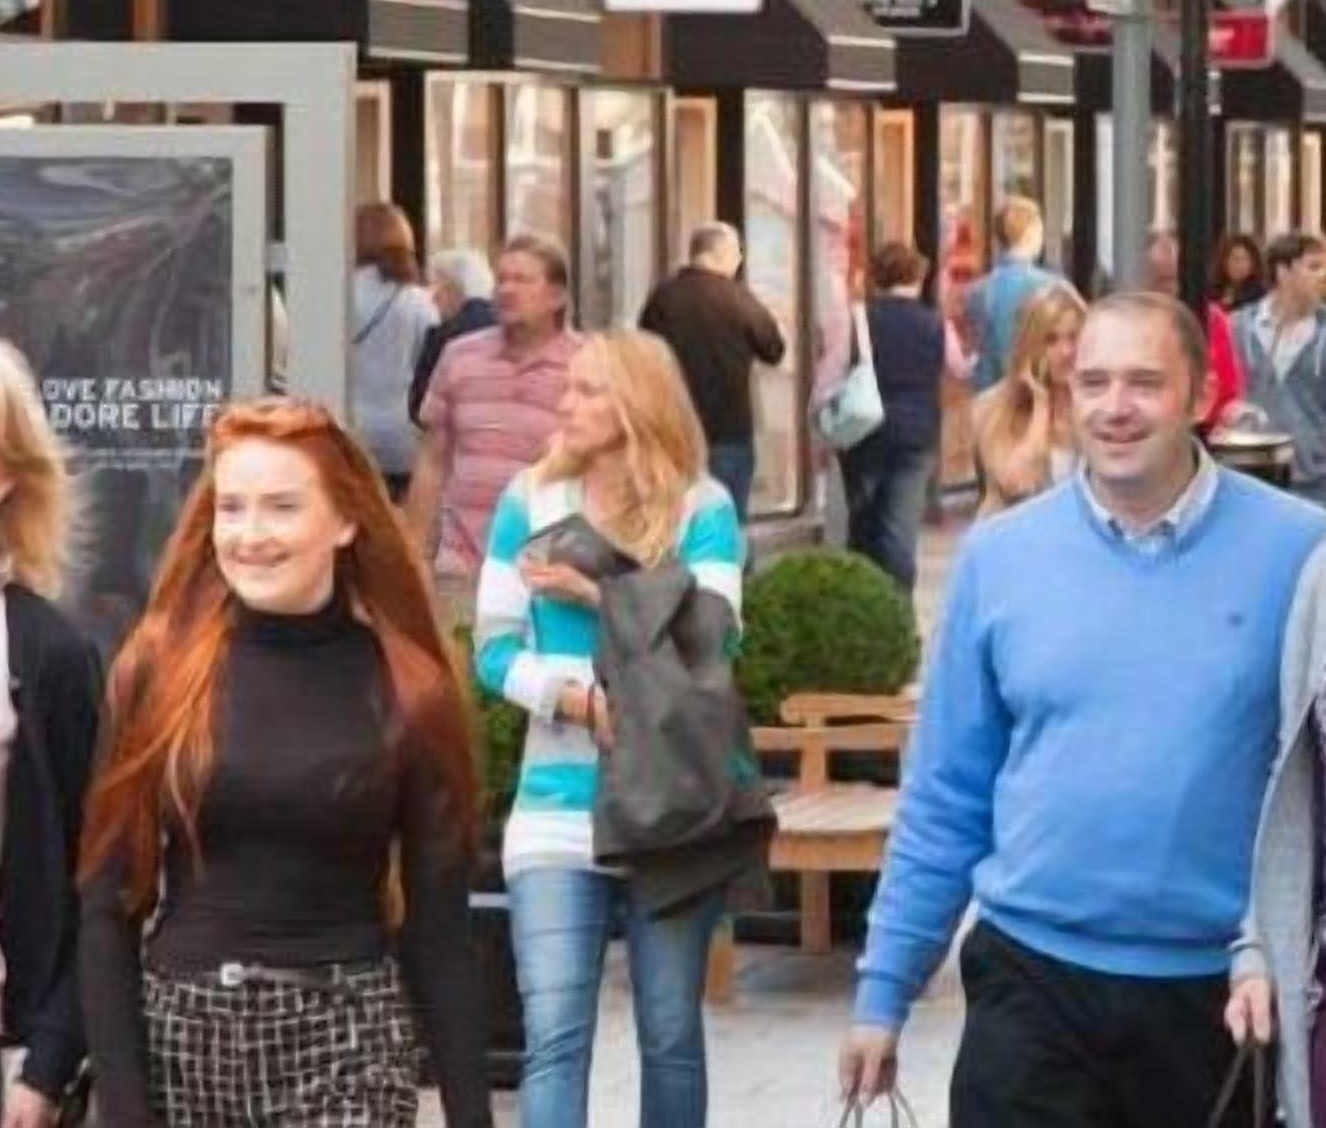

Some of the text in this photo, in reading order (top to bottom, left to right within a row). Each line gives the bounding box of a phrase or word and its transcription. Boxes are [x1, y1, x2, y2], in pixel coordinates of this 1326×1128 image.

[41, 377, 223, 402] OVE FASHION
[49, 403, 141, 431] DORE
